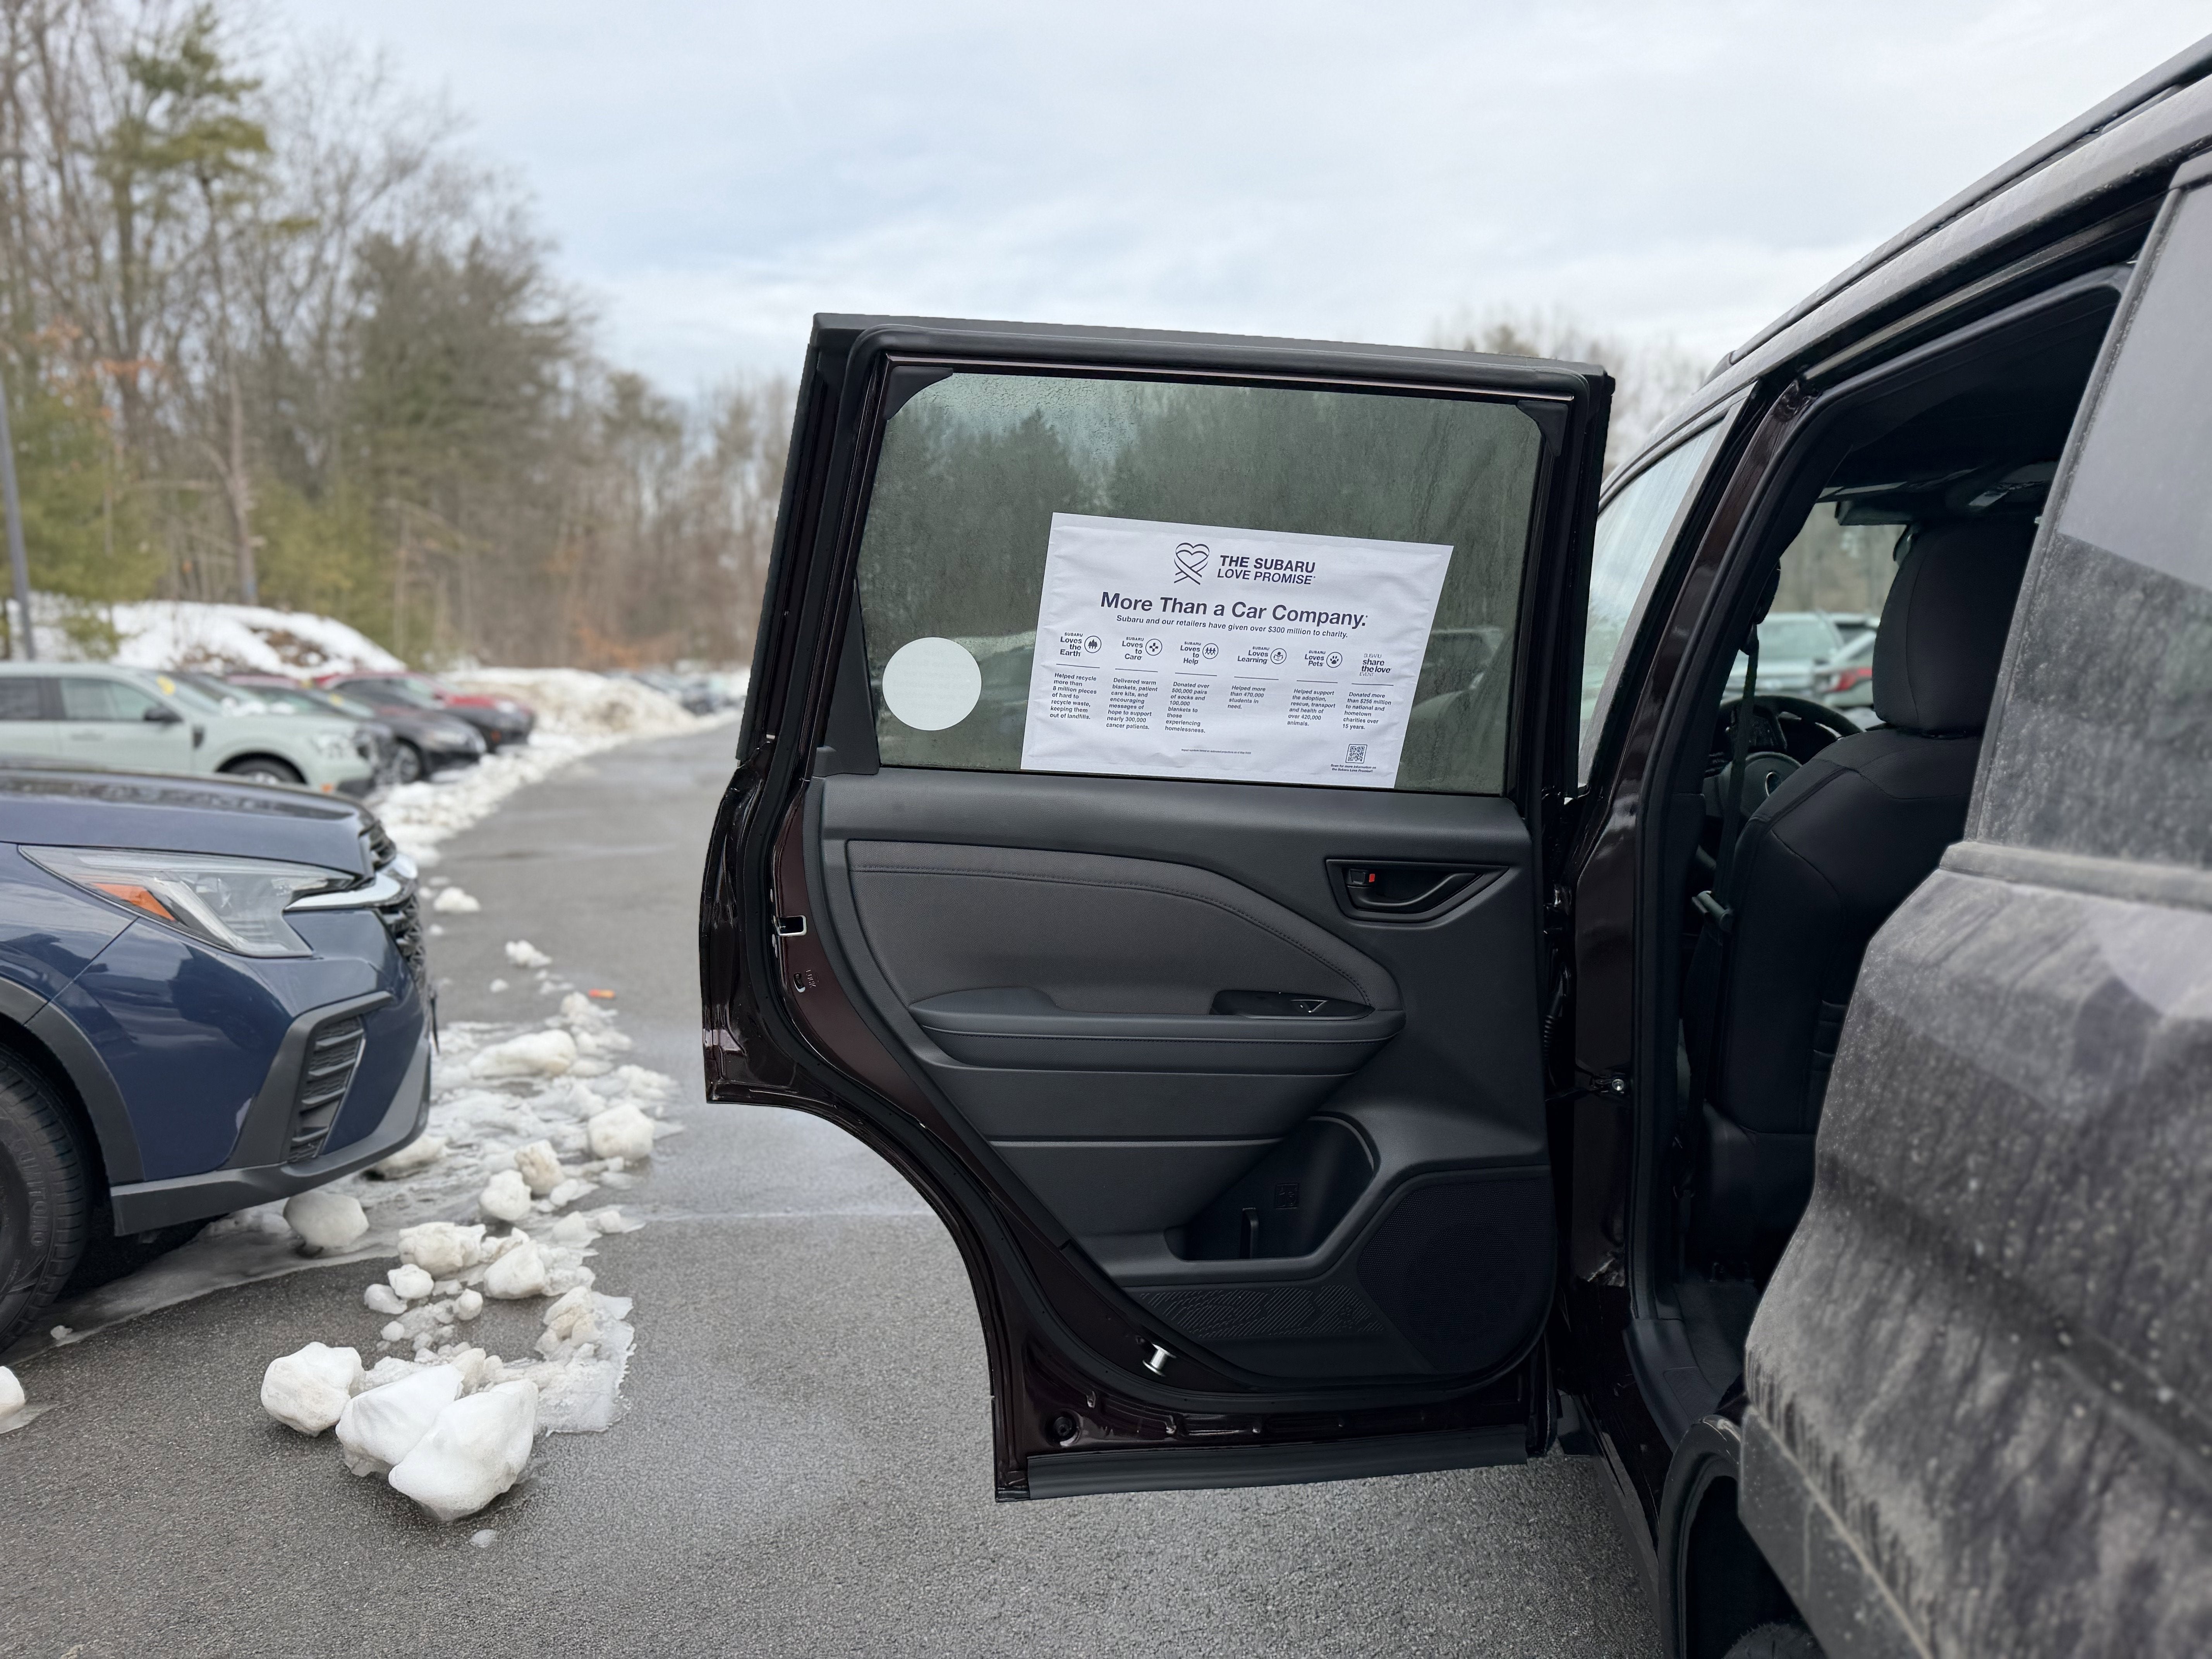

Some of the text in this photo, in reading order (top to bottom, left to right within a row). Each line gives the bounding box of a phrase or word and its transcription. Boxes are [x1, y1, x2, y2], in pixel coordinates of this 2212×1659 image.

[1220, 555, 1315, 573] THE SUBARU
[1217, 568, 1251, 580] LOVE
[1101, 591, 1365, 629] More Than a Car Company.
[1116, 615, 1143, 623] Subaru
[1322, 630, 1347, 639] charity.
[805, 969, 816, 988] LOCK
